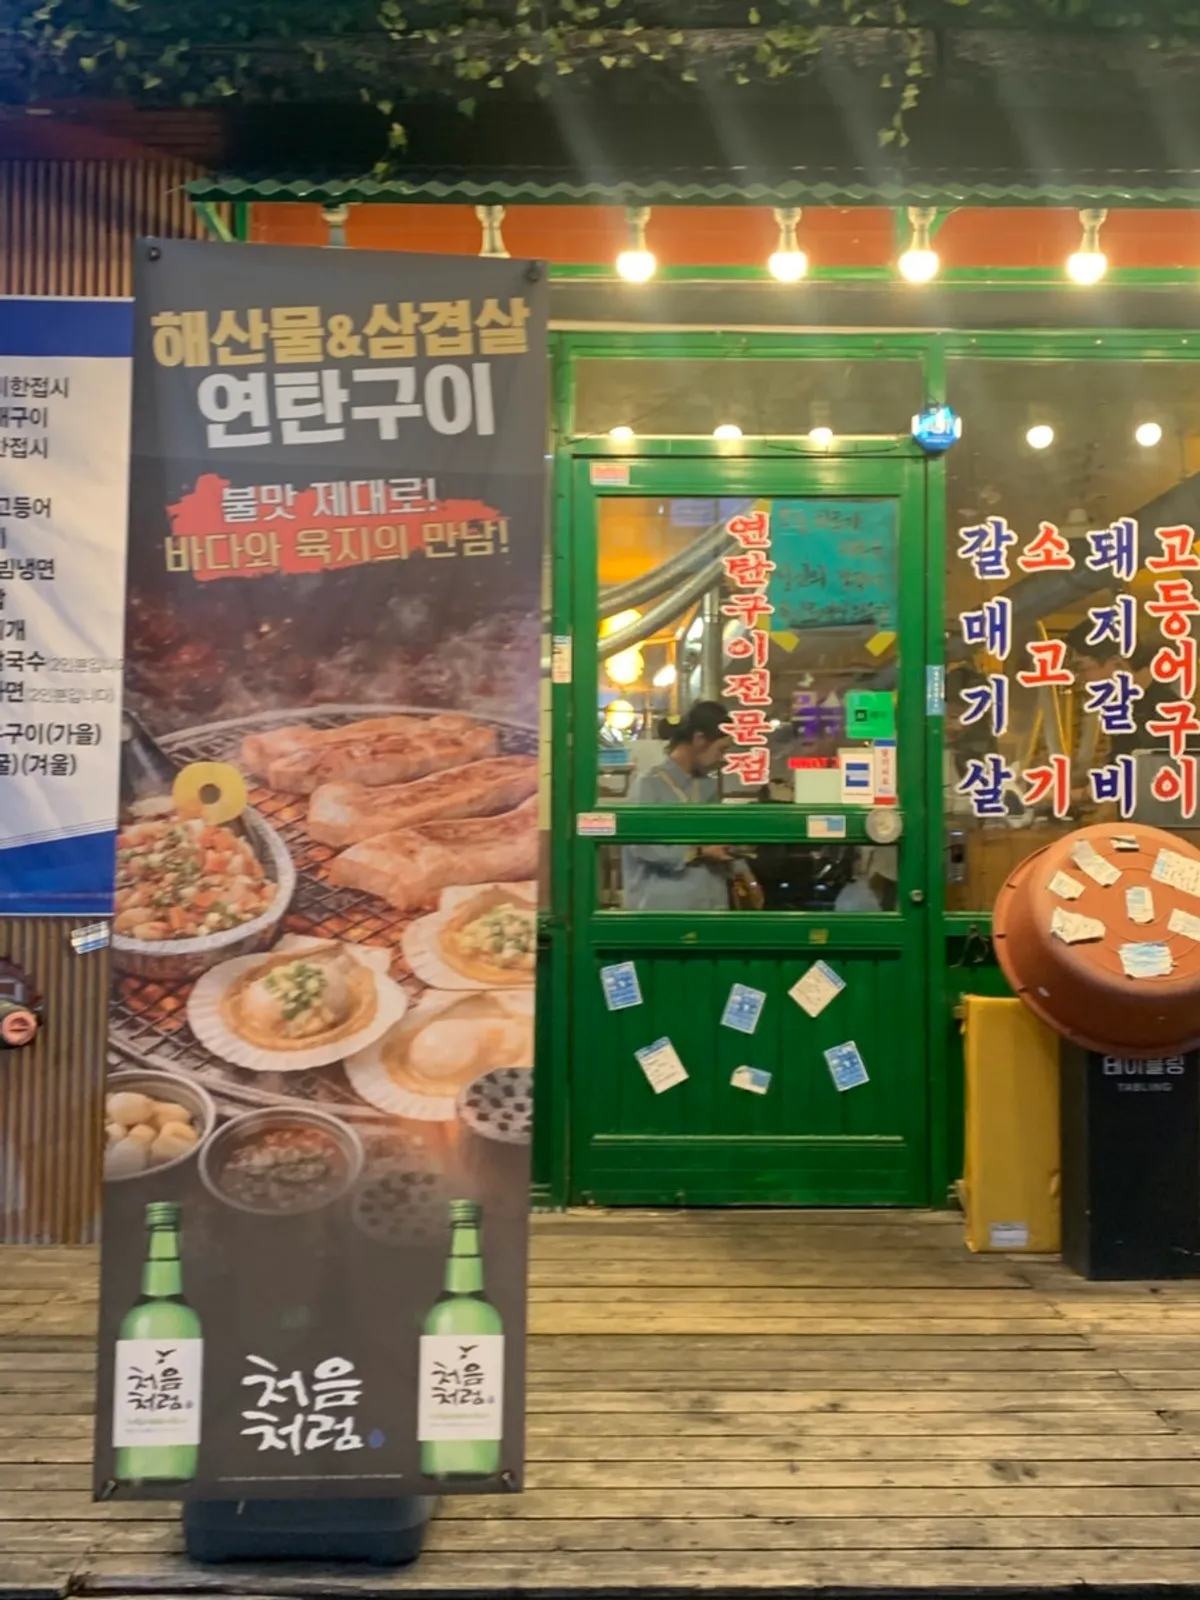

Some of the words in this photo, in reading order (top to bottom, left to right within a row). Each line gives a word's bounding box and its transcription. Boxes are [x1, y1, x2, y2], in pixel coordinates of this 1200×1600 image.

[151, 298, 531, 367] 해산물&삼겹살
[0, 375, 70, 399] 한접시
[197, 362, 494, 448] 연탄구이
[221, 484, 298, 524] 불맛
[310, 477, 437, 517] 제대로!
[164, 531, 282, 572] 바다와
[295, 525, 409, 564] 육지의
[421, 517, 511, 558] 만남!
[0, 650, 46, 672] 국수
[719, 510, 776, 786] 연탄구이전문점
[957, 516, 1018, 816] 갈매기살
[1018, 521, 1075, 817] 소고기
[1085, 516, 1144, 819] 돼지갈비
[1145, 524, 1200, 819] 고등어구이
[127, 1366, 184, 1391] 처음
[241, 1354, 363, 1409] 처음
[431, 1361, 485, 1386] 처음
[431, 1386, 485, 1407] 처럼
[126, 1391, 183, 1412] 처럼
[240, 1410, 364, 1457] 처럼
